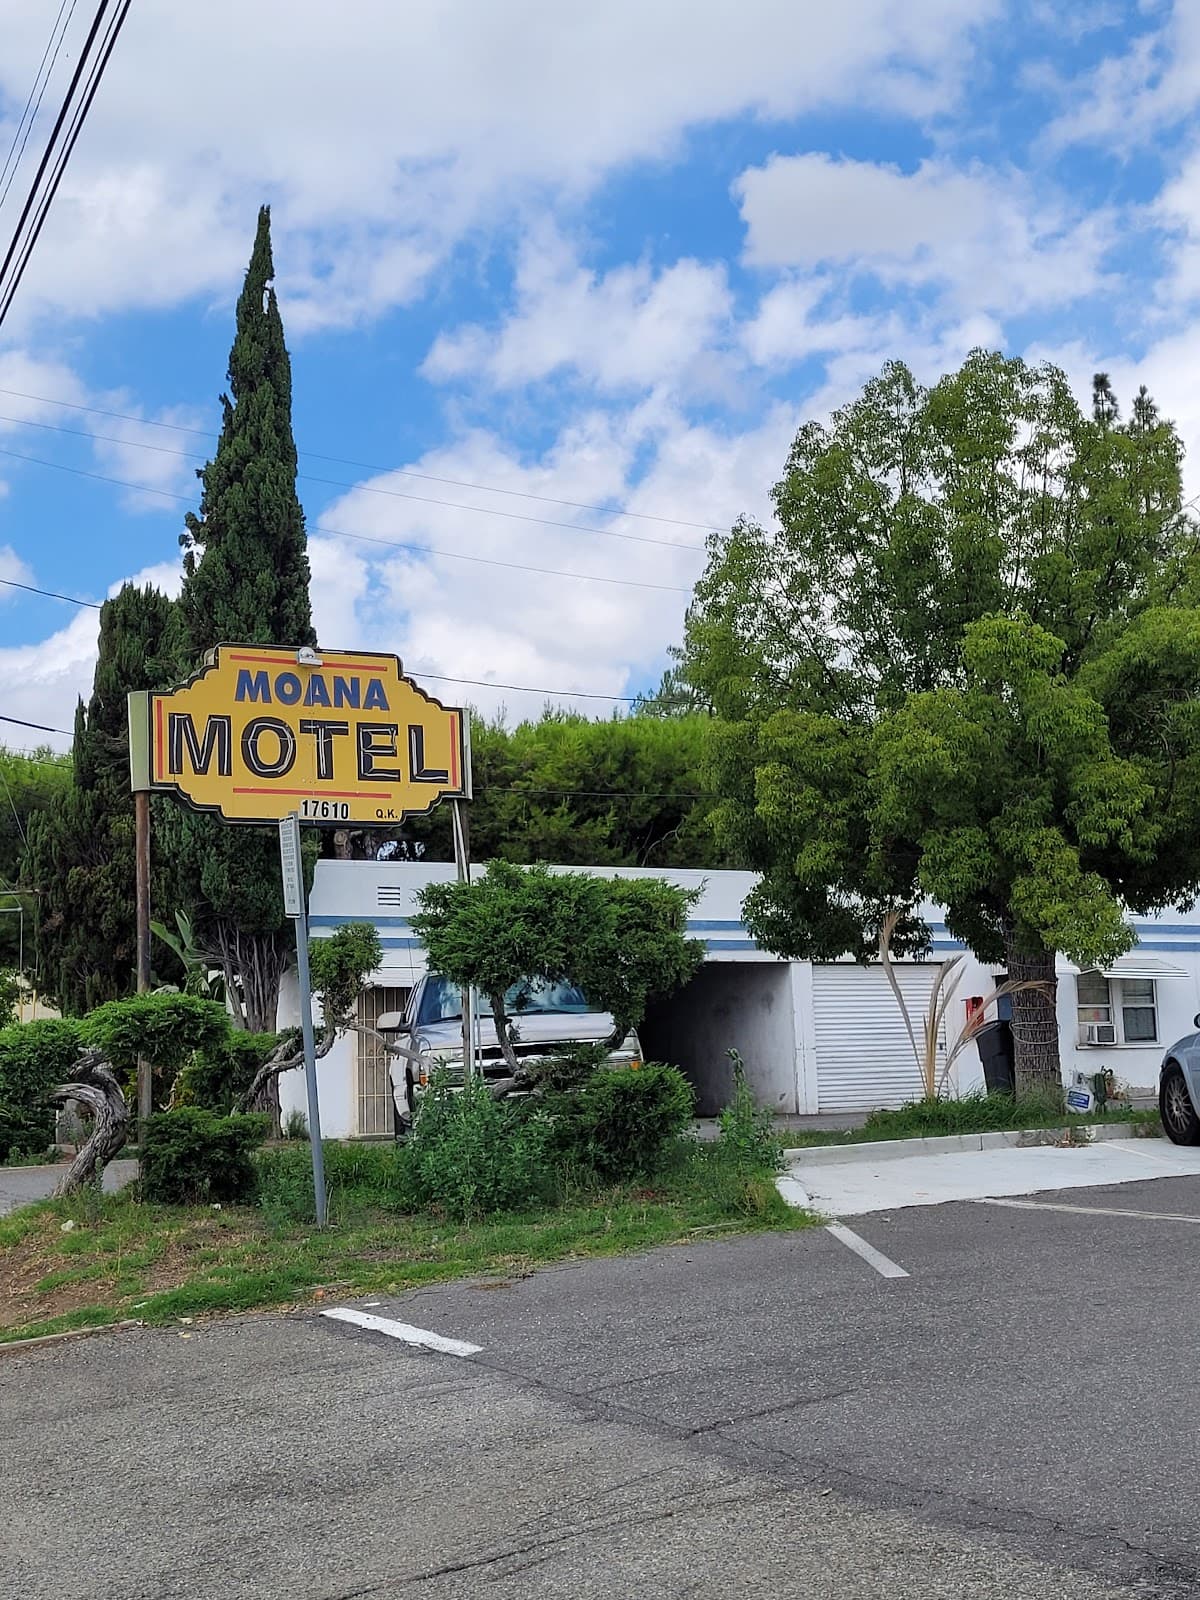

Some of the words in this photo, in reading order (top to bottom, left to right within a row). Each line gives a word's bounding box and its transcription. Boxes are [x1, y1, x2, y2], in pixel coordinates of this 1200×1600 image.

[235, 669, 390, 711] MOANA
[168, 713, 449, 784] MOTEL
[302, 800, 349, 819] 17610
